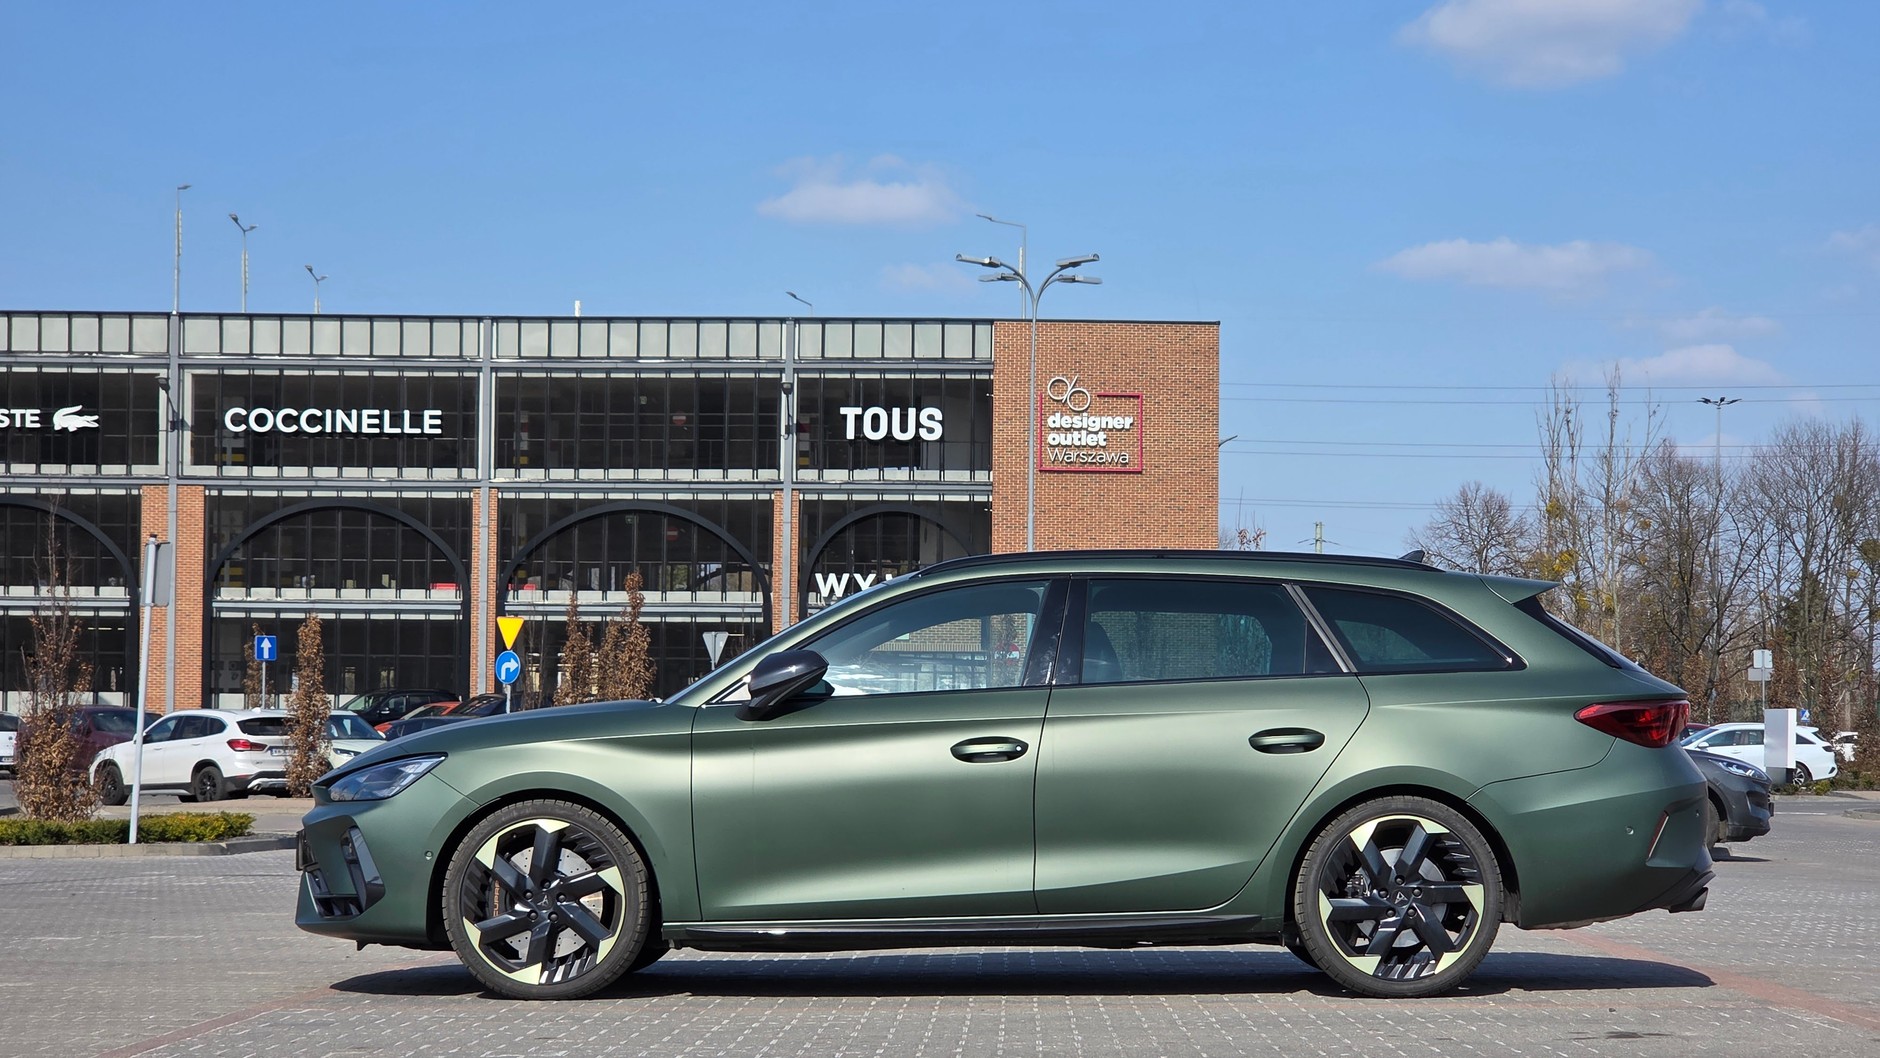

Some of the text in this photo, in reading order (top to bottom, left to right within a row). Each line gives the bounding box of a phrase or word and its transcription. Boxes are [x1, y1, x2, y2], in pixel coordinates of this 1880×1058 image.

[224, 407, 442, 434] COCCINELLE
[839, 406, 943, 441] TOUS
[1047, 412, 1134, 432] designer
[1047, 430, 1107, 447] outlet
[1047, 447, 1129, 464] Warszawa
